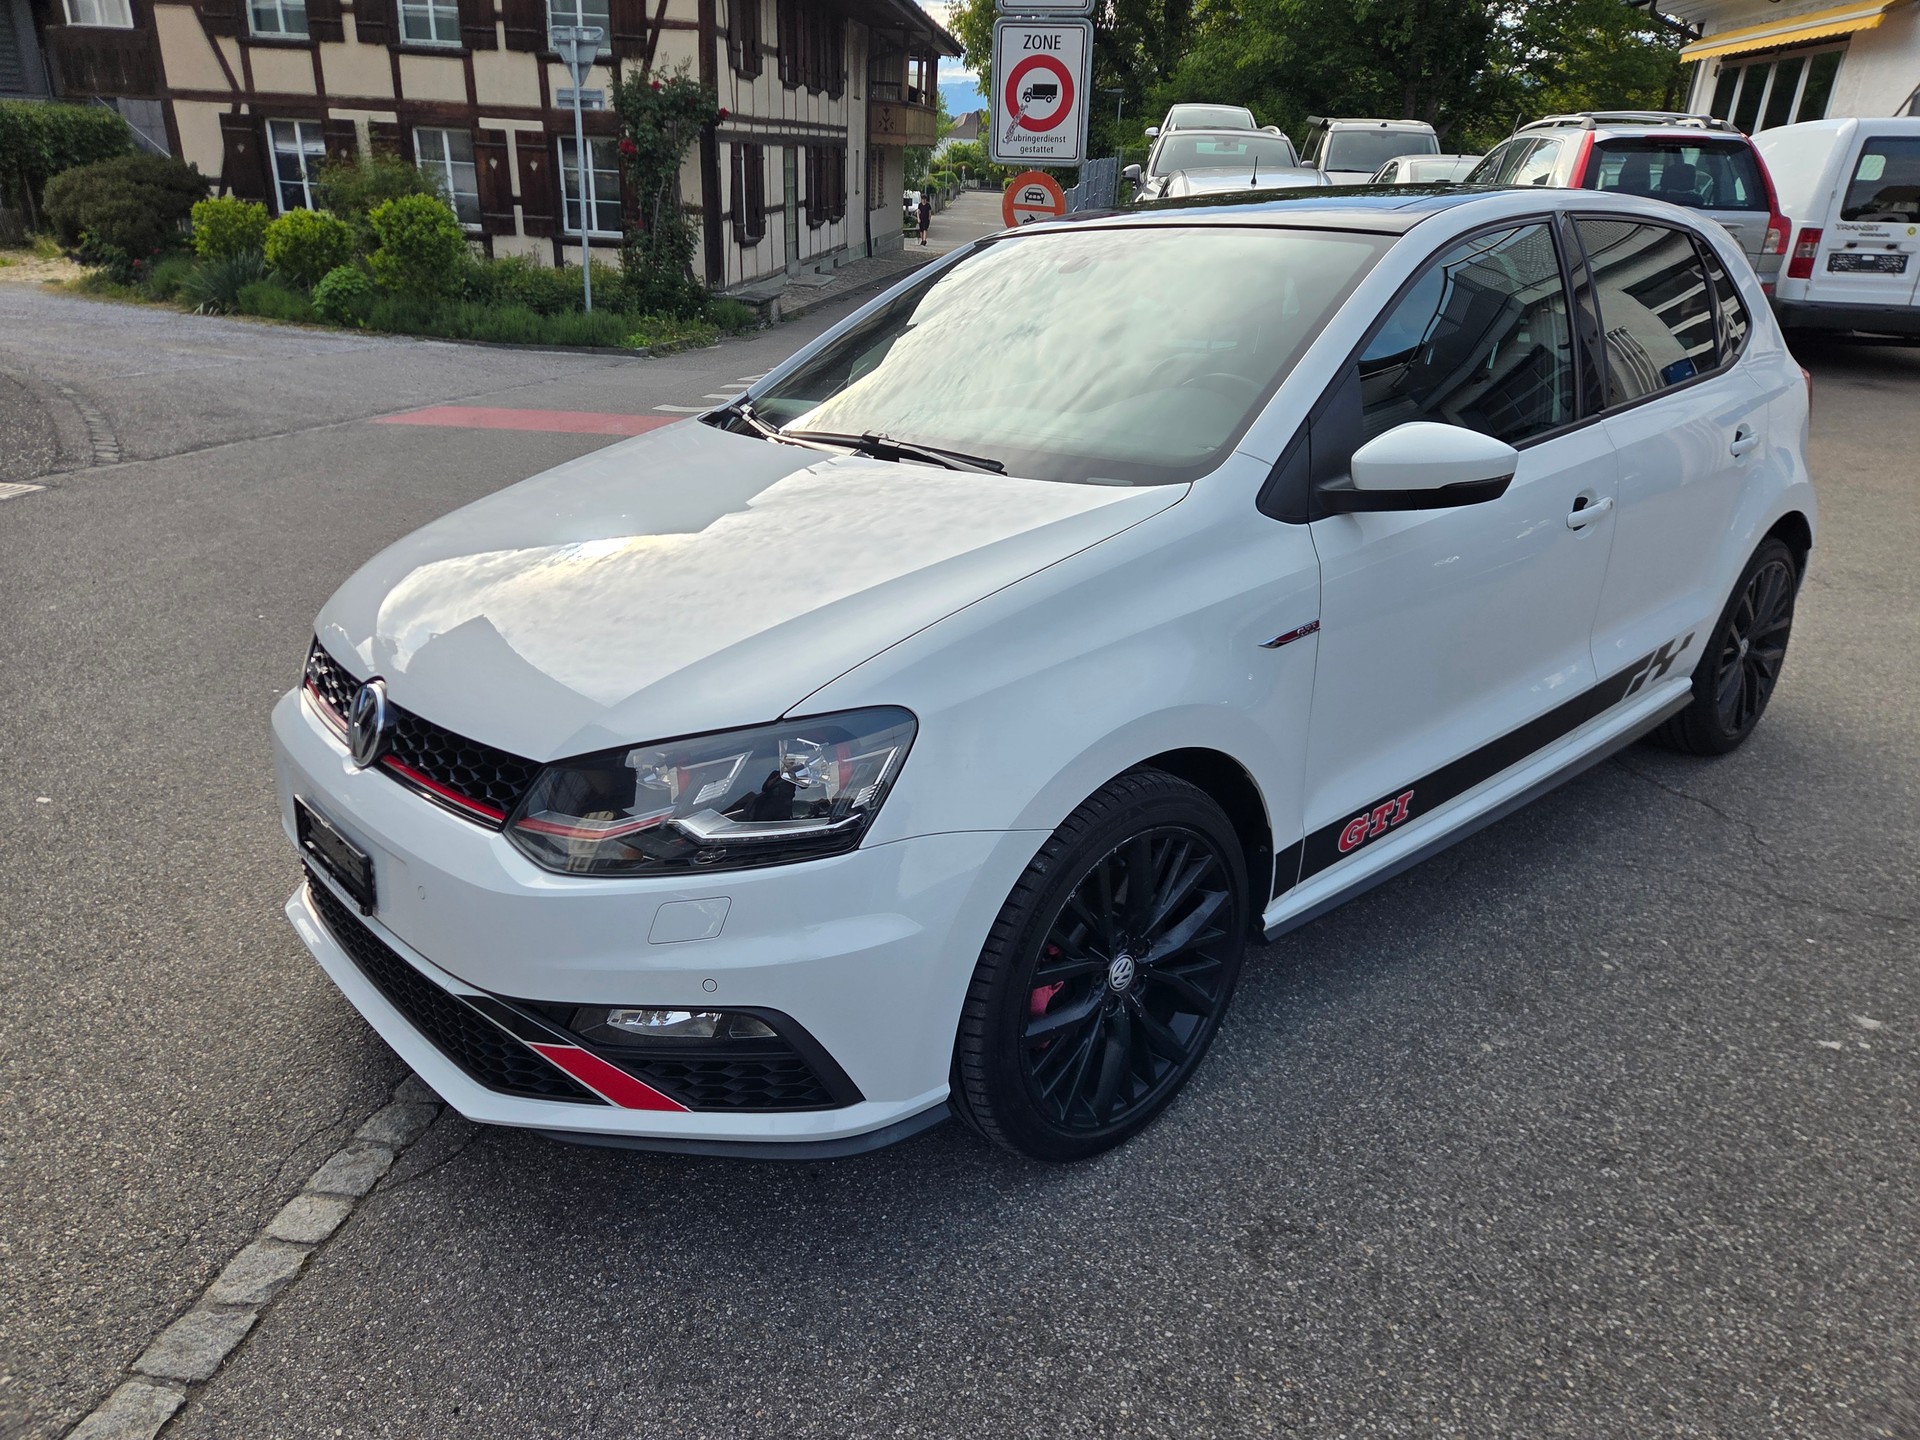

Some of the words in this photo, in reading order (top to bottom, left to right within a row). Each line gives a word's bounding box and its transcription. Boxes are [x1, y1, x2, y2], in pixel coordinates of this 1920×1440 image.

[1023, 34, 1062, 50] ZONE
[1020, 146, 1054, 154] gestattet
[1337, 789, 1415, 853] GTI
